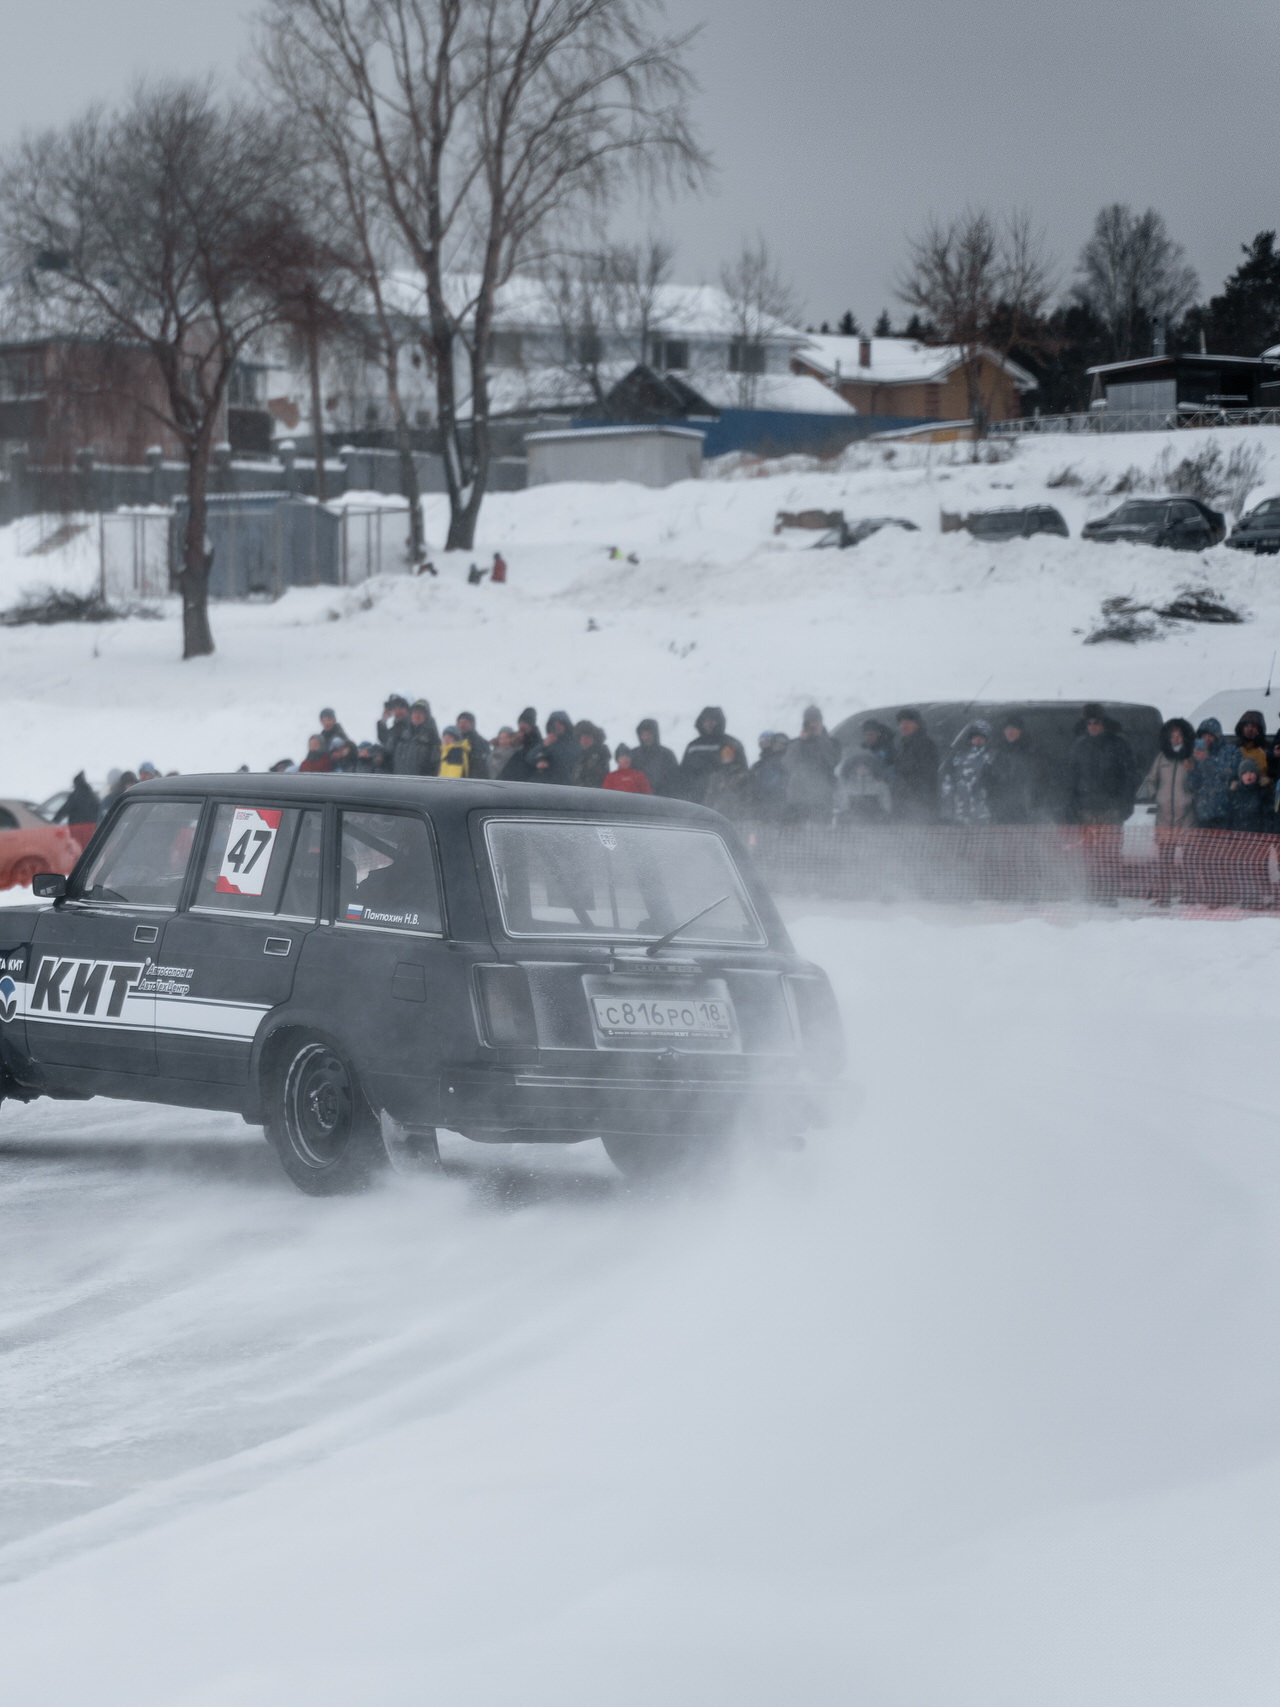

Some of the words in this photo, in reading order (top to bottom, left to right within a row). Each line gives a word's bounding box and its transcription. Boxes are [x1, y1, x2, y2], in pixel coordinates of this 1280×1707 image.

[227, 829, 272, 874] 47
[364, 908, 404, 923] Пантюхин
[404, 913, 420, 925] Н.В.
[8, 959, 24, 971] КИТ
[606, 1003, 695, 1026] С816РО
[699, 1003, 721, 1021] 18
